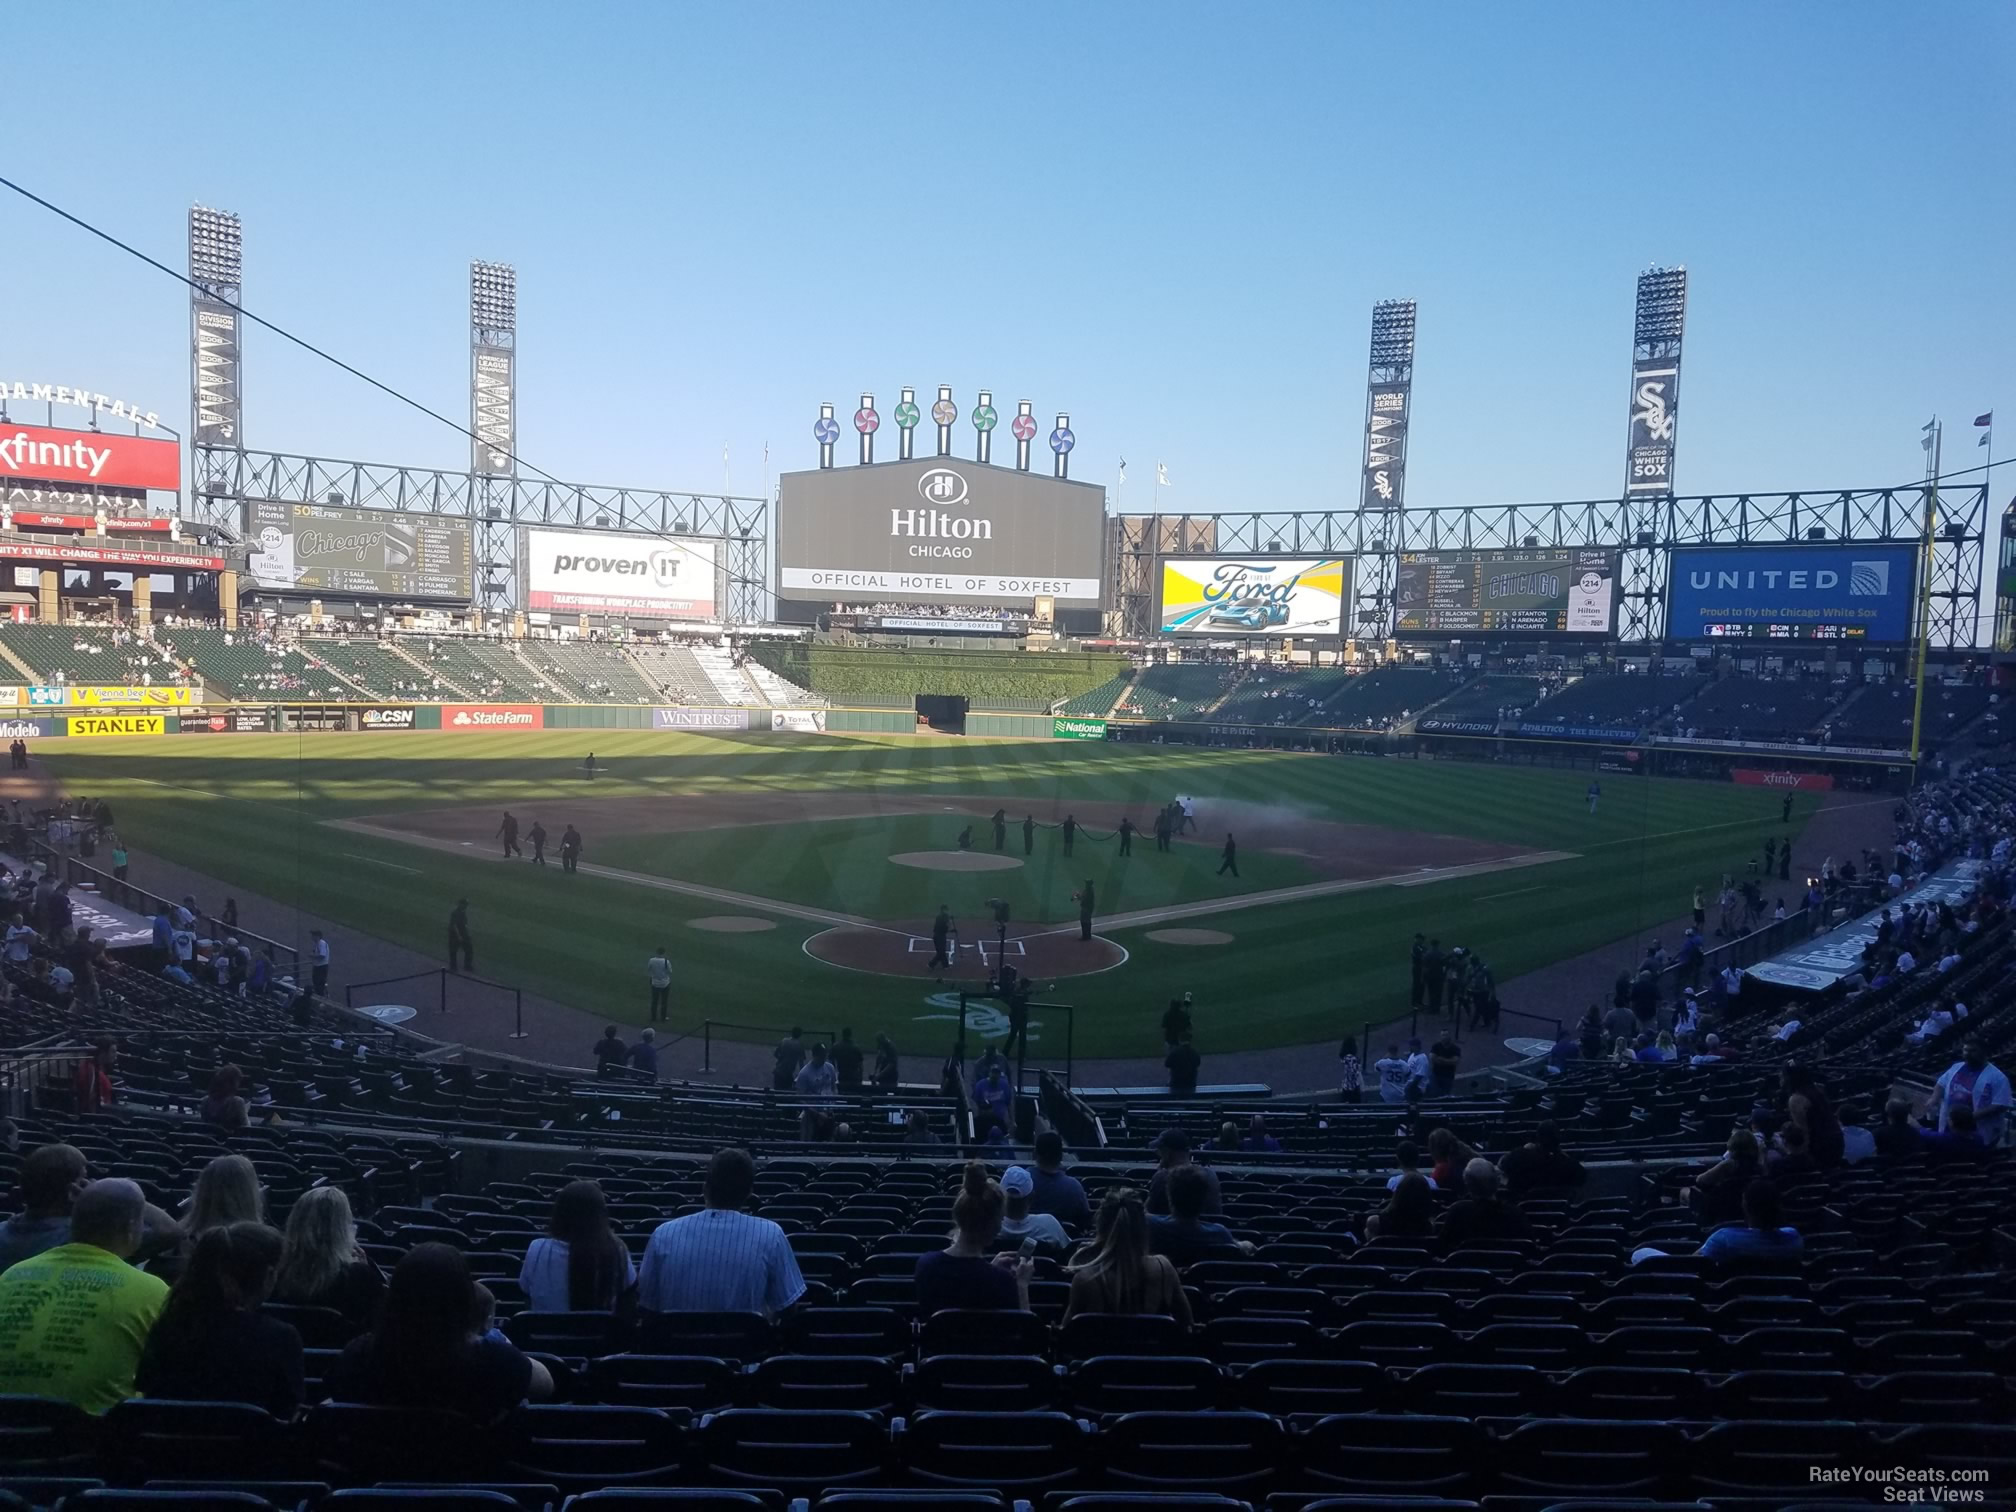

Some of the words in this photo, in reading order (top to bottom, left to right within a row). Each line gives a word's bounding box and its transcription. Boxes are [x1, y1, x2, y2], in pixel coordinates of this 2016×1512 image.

[200, 314, 233, 325] DIVISION
[478, 355, 508, 363] AMERICAN
[479, 360, 508, 370] LEAGUE
[1374, 393, 1404, 401] WORLD
[1374, 399, 1403, 408] SERIES
[1634, 464, 1666, 476] SOX
[258, 504, 277, 512] Drive
[294, 505, 311, 516] 50
[258, 511, 285, 519] Home
[311, 510, 342, 519] PELFREY
[40, 516, 64, 526] xfinity
[106, 519, 151, 528] xfinity.com/x1
[891, 509, 992, 539] Hilton
[263, 534, 280, 542] $214
[296, 529, 384, 562] Chicago
[34, 548, 59, 557] WILL
[60, 549, 100, 559] CHANGE
[103, 552, 119, 560] THE
[122, 553, 141, 561] WAY
[142, 553, 160, 562] YOU
[161, 555, 204, 566] EXPERIENCE
[909, 545, 973, 559] CHICAGO
[1401, 554, 1415, 563] 34
[260, 562, 284, 570] Hilton
[553, 554, 648, 575] proven
[661, 558, 680, 577] IT
[811, 573, 888, 587] OFFICIAL
[900, 576, 953, 590] HOTEL
[965, 578, 986, 591] OF
[999, 580, 1071, 594] SOXFEST
[1203, 563, 1300, 602] Ford
[1489, 571, 1559, 599] CHICAGO
[1690, 570, 1838, 589] UNITED
[606, 597, 647, 608] WORKPLACE
[647, 600, 693, 610] PRODUCTIVITY
[1700, 608, 1732, 616] Proud
[1732, 608, 1742, 616] to
[1744, 608, 1757, 618] fly
[1761, 608, 1778, 616] the
[1780, 608, 1820, 618] Chicago
[1823, 608, 1855, 617] White
[1858, 608, 1877, 617] Sox
[92, 688, 124, 697] Vienna
[127, 688, 147, 697] Beef
[382, 710, 413, 722] CSN
[660, 710, 742, 725] WINTRUST
[0, 722, 39, 737] Modelo
[75, 719, 157, 734] STANLEY
[1066, 722, 1105, 733] National
[1442, 722, 1492, 731] HYUNDAI
[1521, 723, 1564, 733] ATHLETICO
[1589, 729, 1637, 738] RELIEVERS
[1763, 773, 1801, 786] xfinity
[1387, 1071, 1402, 1083] 35
